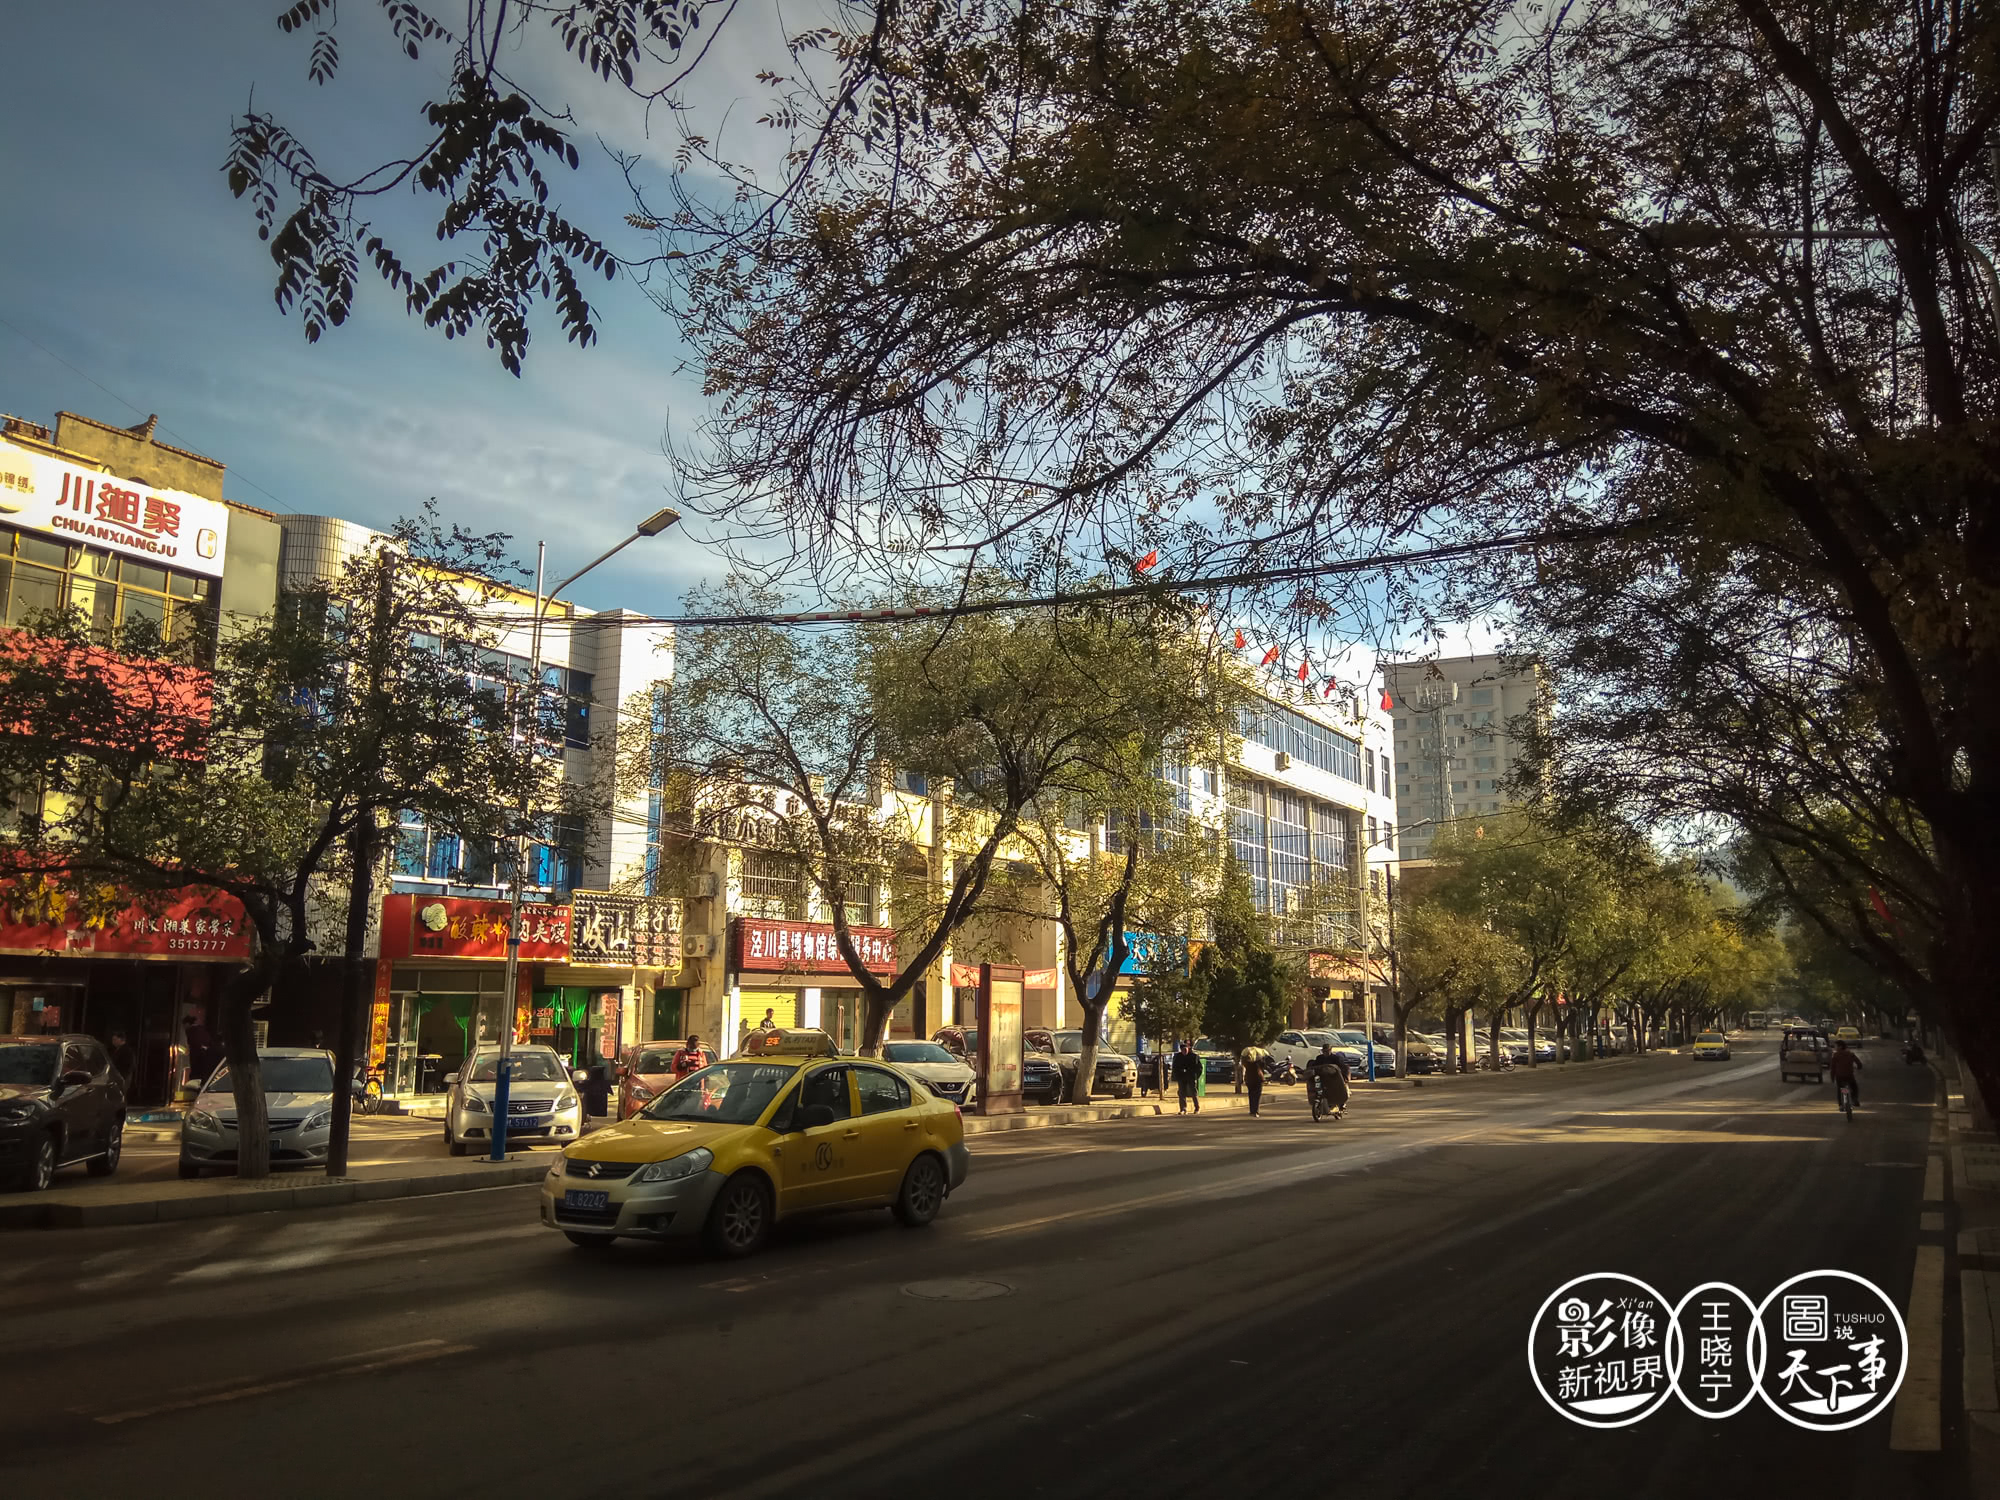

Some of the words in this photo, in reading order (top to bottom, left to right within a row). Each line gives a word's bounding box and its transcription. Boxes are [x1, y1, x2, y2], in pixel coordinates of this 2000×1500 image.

[55, 472, 181, 539] 川湘聚
[51, 515, 177, 558] CHUANXIANGJU
[169, 938, 227, 951] 3513777
[750, 929, 892, 963] 泾川县博物馆综服务中心
